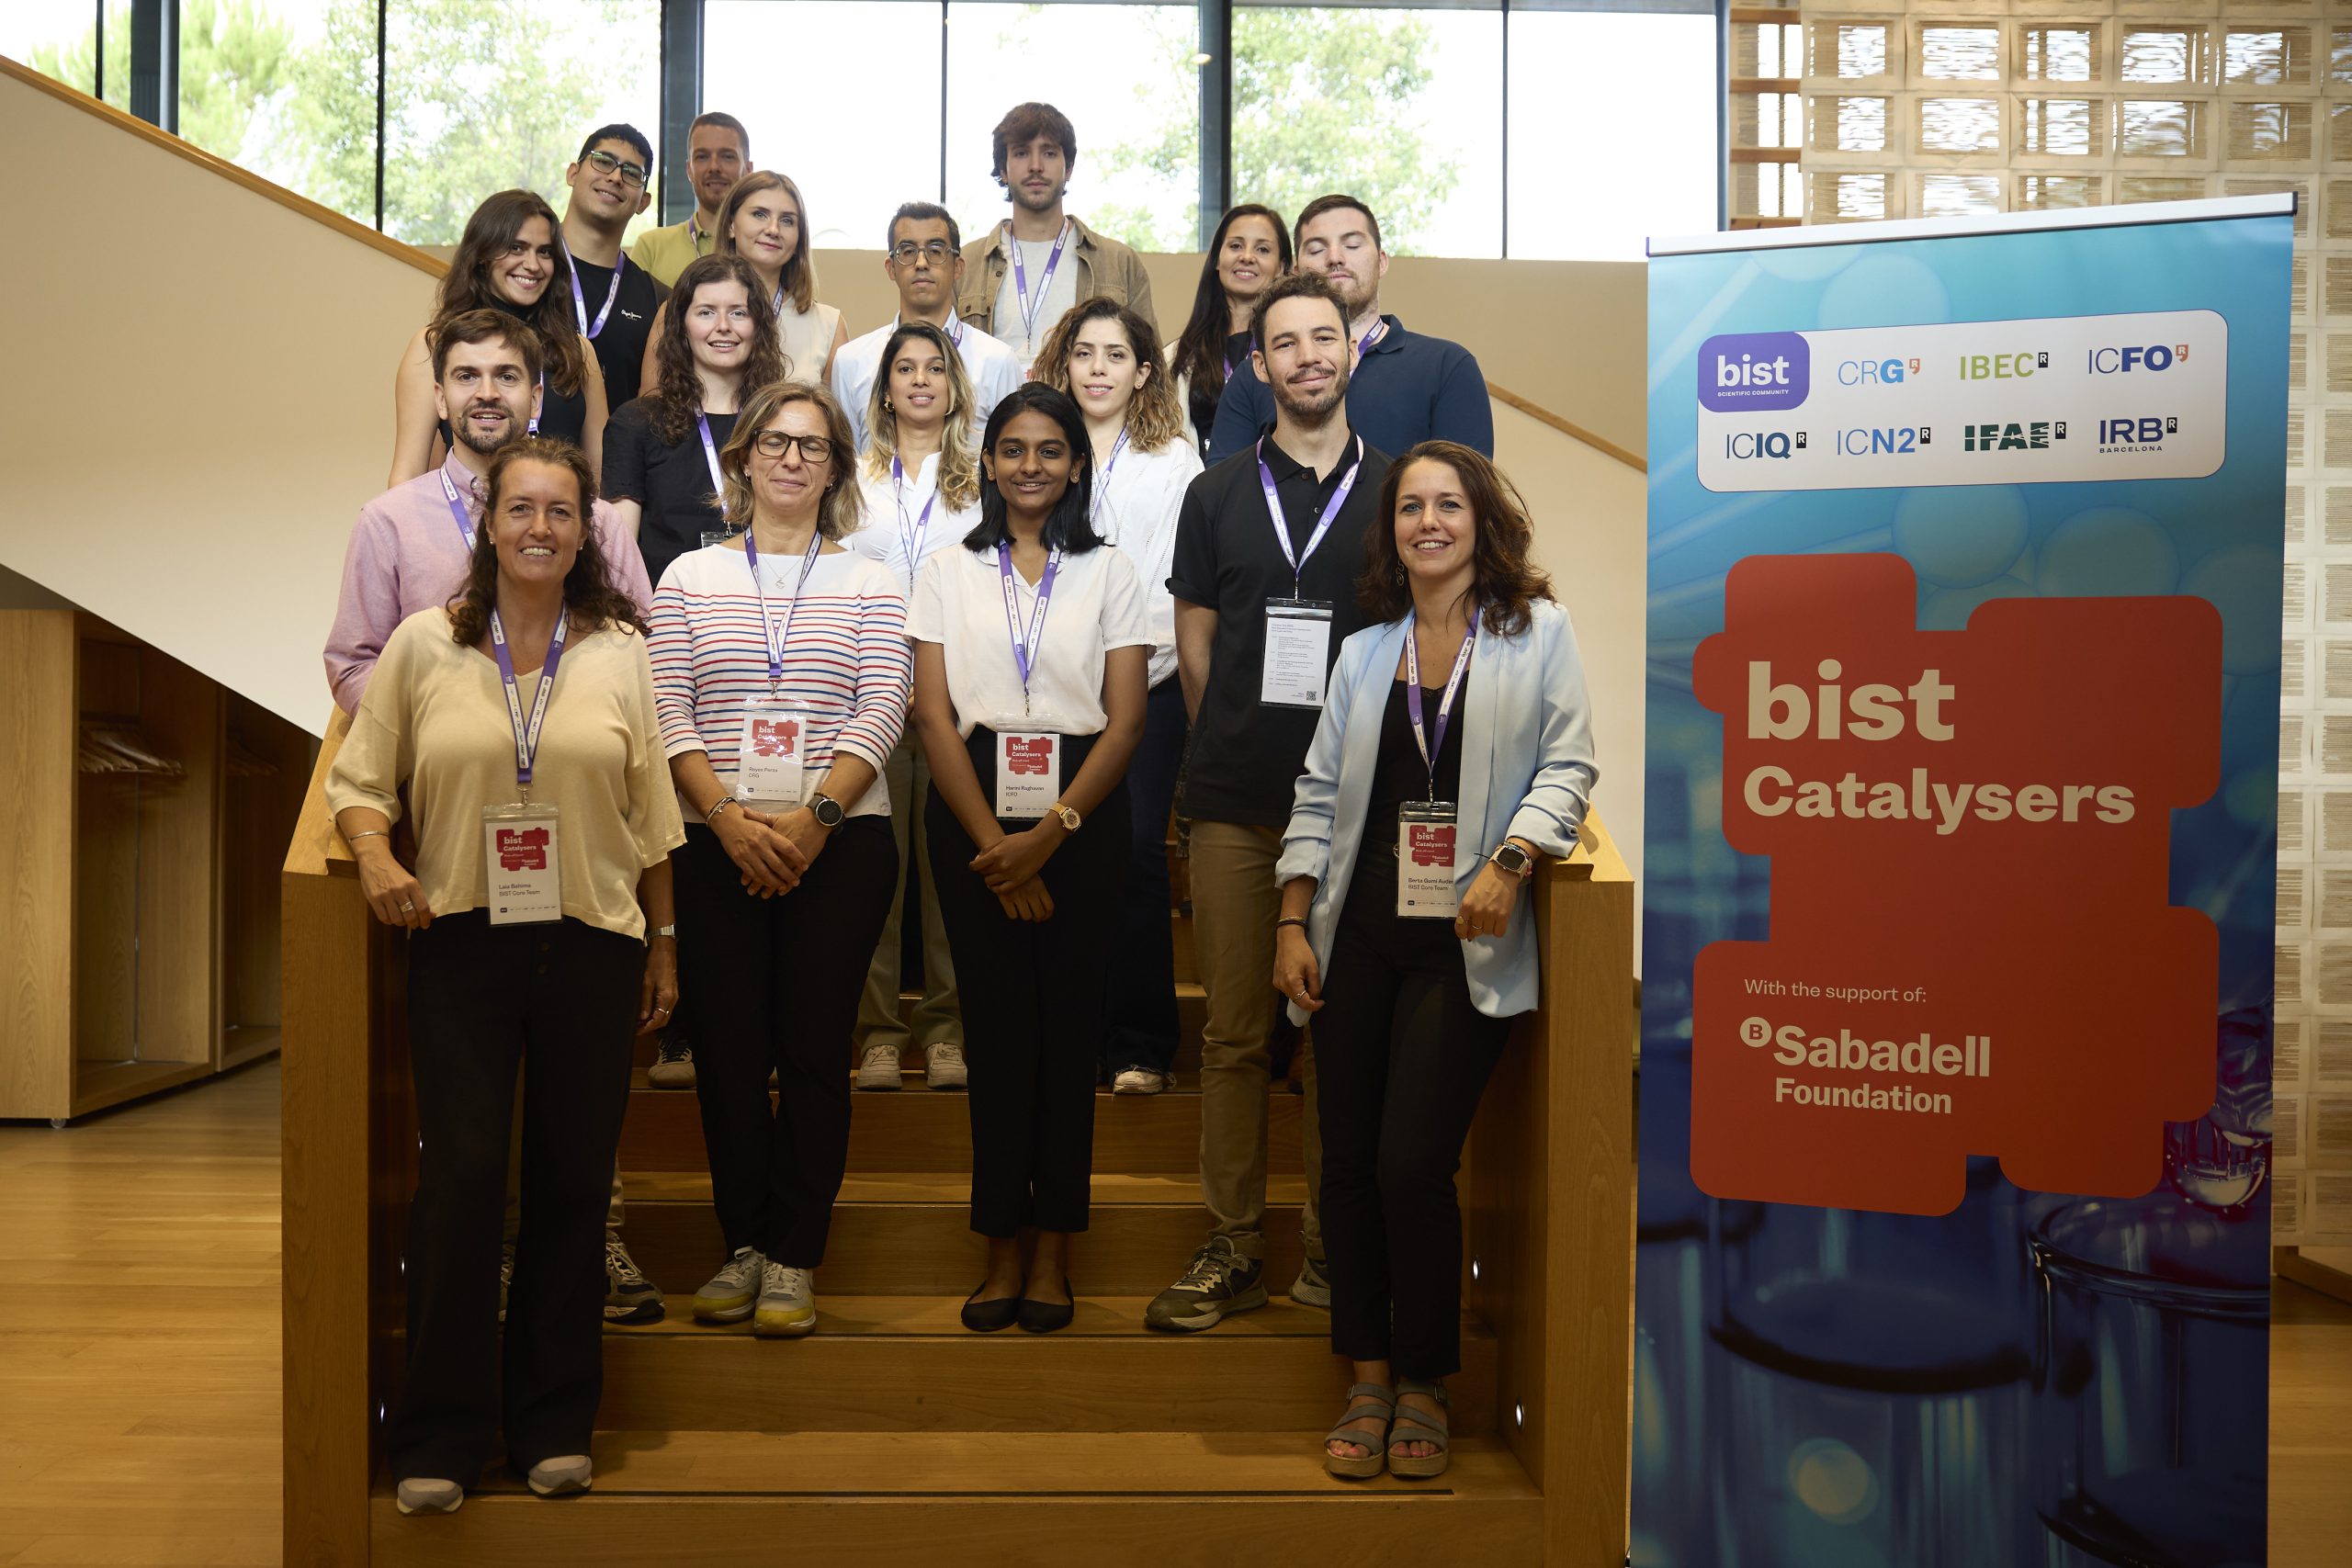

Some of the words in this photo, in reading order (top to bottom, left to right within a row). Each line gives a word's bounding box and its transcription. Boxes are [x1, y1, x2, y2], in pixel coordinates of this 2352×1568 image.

[1717, 354, 1790, 387] bist
[1838, 358, 1905, 386] CRG
[1960, 353, 2034, 380] IBEC
[2088, 344, 2173, 375] ICFO
[1838, 427, 1916, 456] ICN2
[1964, 422, 2050, 452] IFAE
[2099, 417, 2164, 445] IRB
[1726, 432, 1792, 459] ICIQ
[2099, 446, 2163, 454] BARCELONA
[1747, 659, 1955, 741] bist
[1744, 765, 2135, 835] Catalysers
[503, 836, 523, 844] bist
[503, 844, 537, 852] Catalysers
[1417, 832, 1434, 840] bist
[1744, 978, 1786, 996] With
[1791, 981, 1821, 998] the
[1826, 986, 1899, 1004] support
[1903, 987, 1927, 1003] of:
[1773, 1025, 1990, 1077] Sabadell
[1776, 1077, 1952, 1114] Foundation
